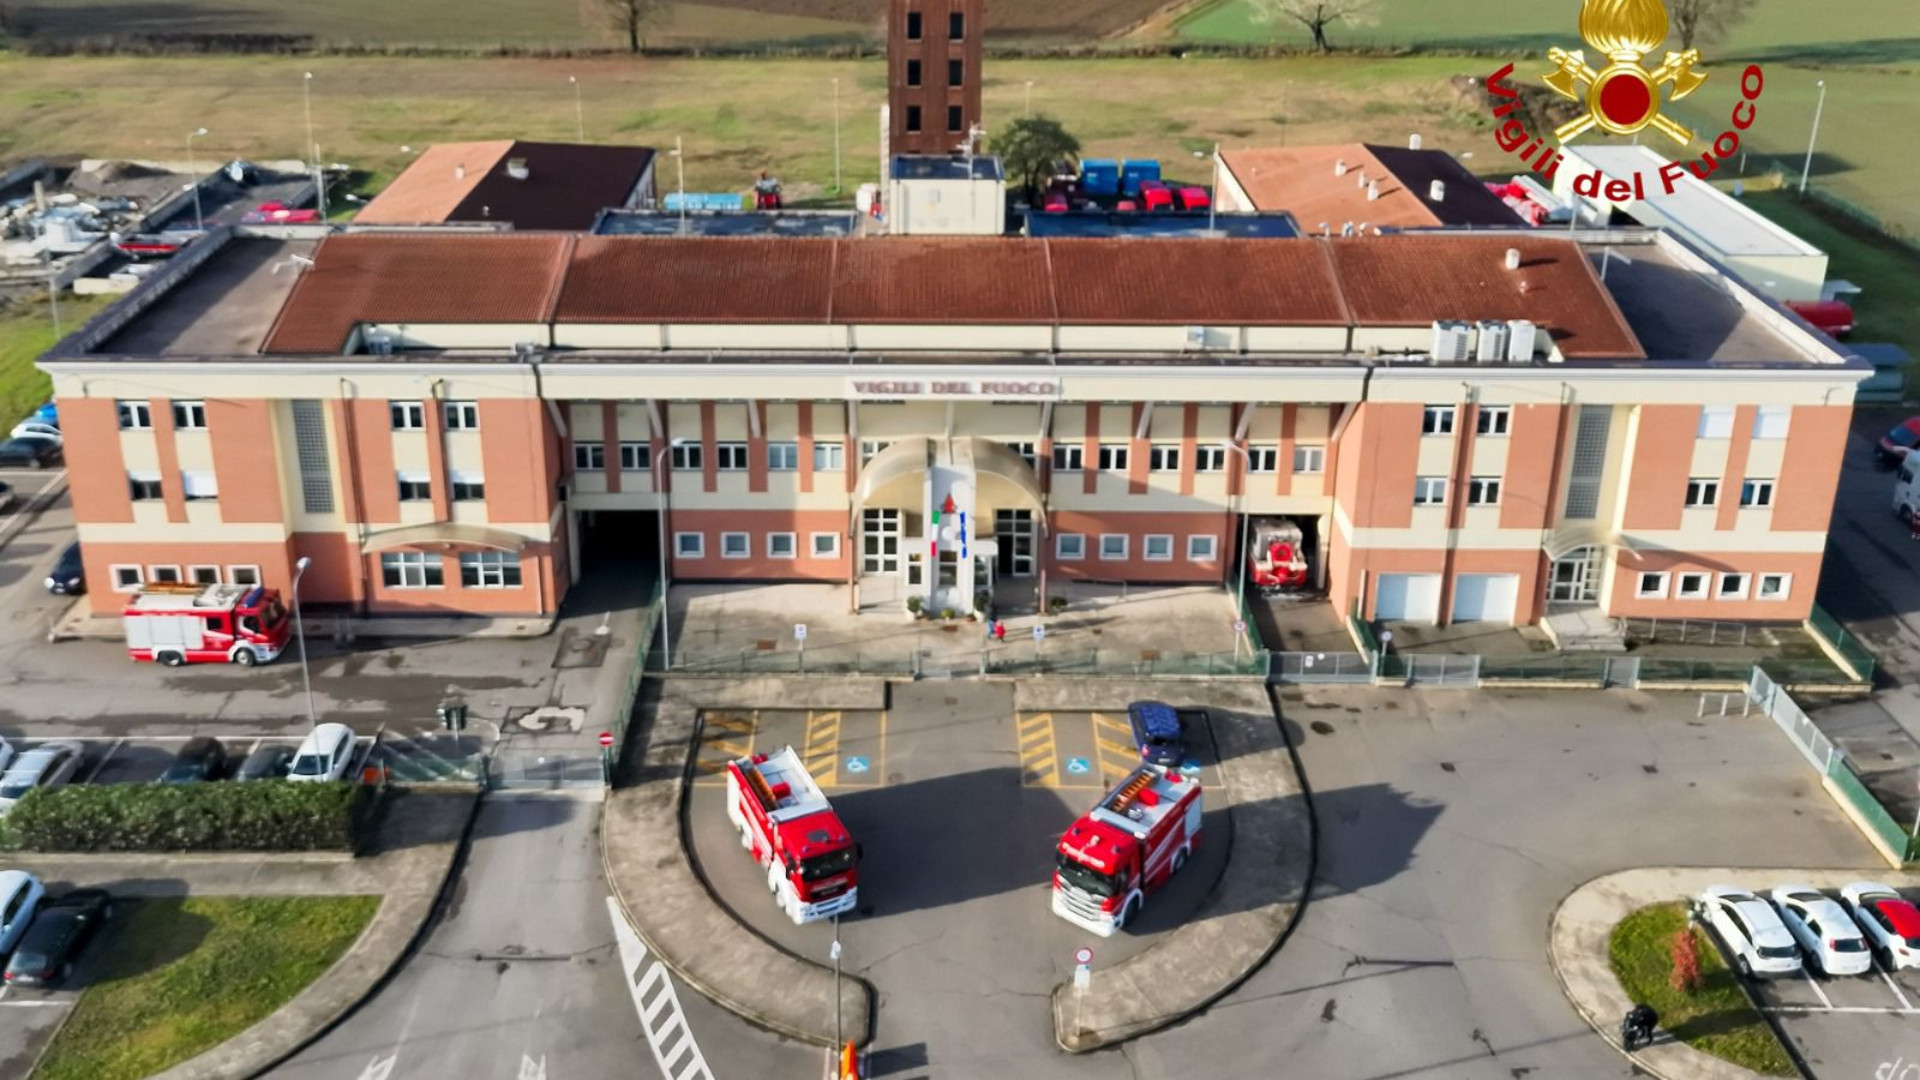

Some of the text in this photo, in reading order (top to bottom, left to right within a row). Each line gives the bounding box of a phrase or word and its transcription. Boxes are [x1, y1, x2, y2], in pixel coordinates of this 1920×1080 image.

[853, 380, 1058, 395] VIGILI DEL FUOCO
